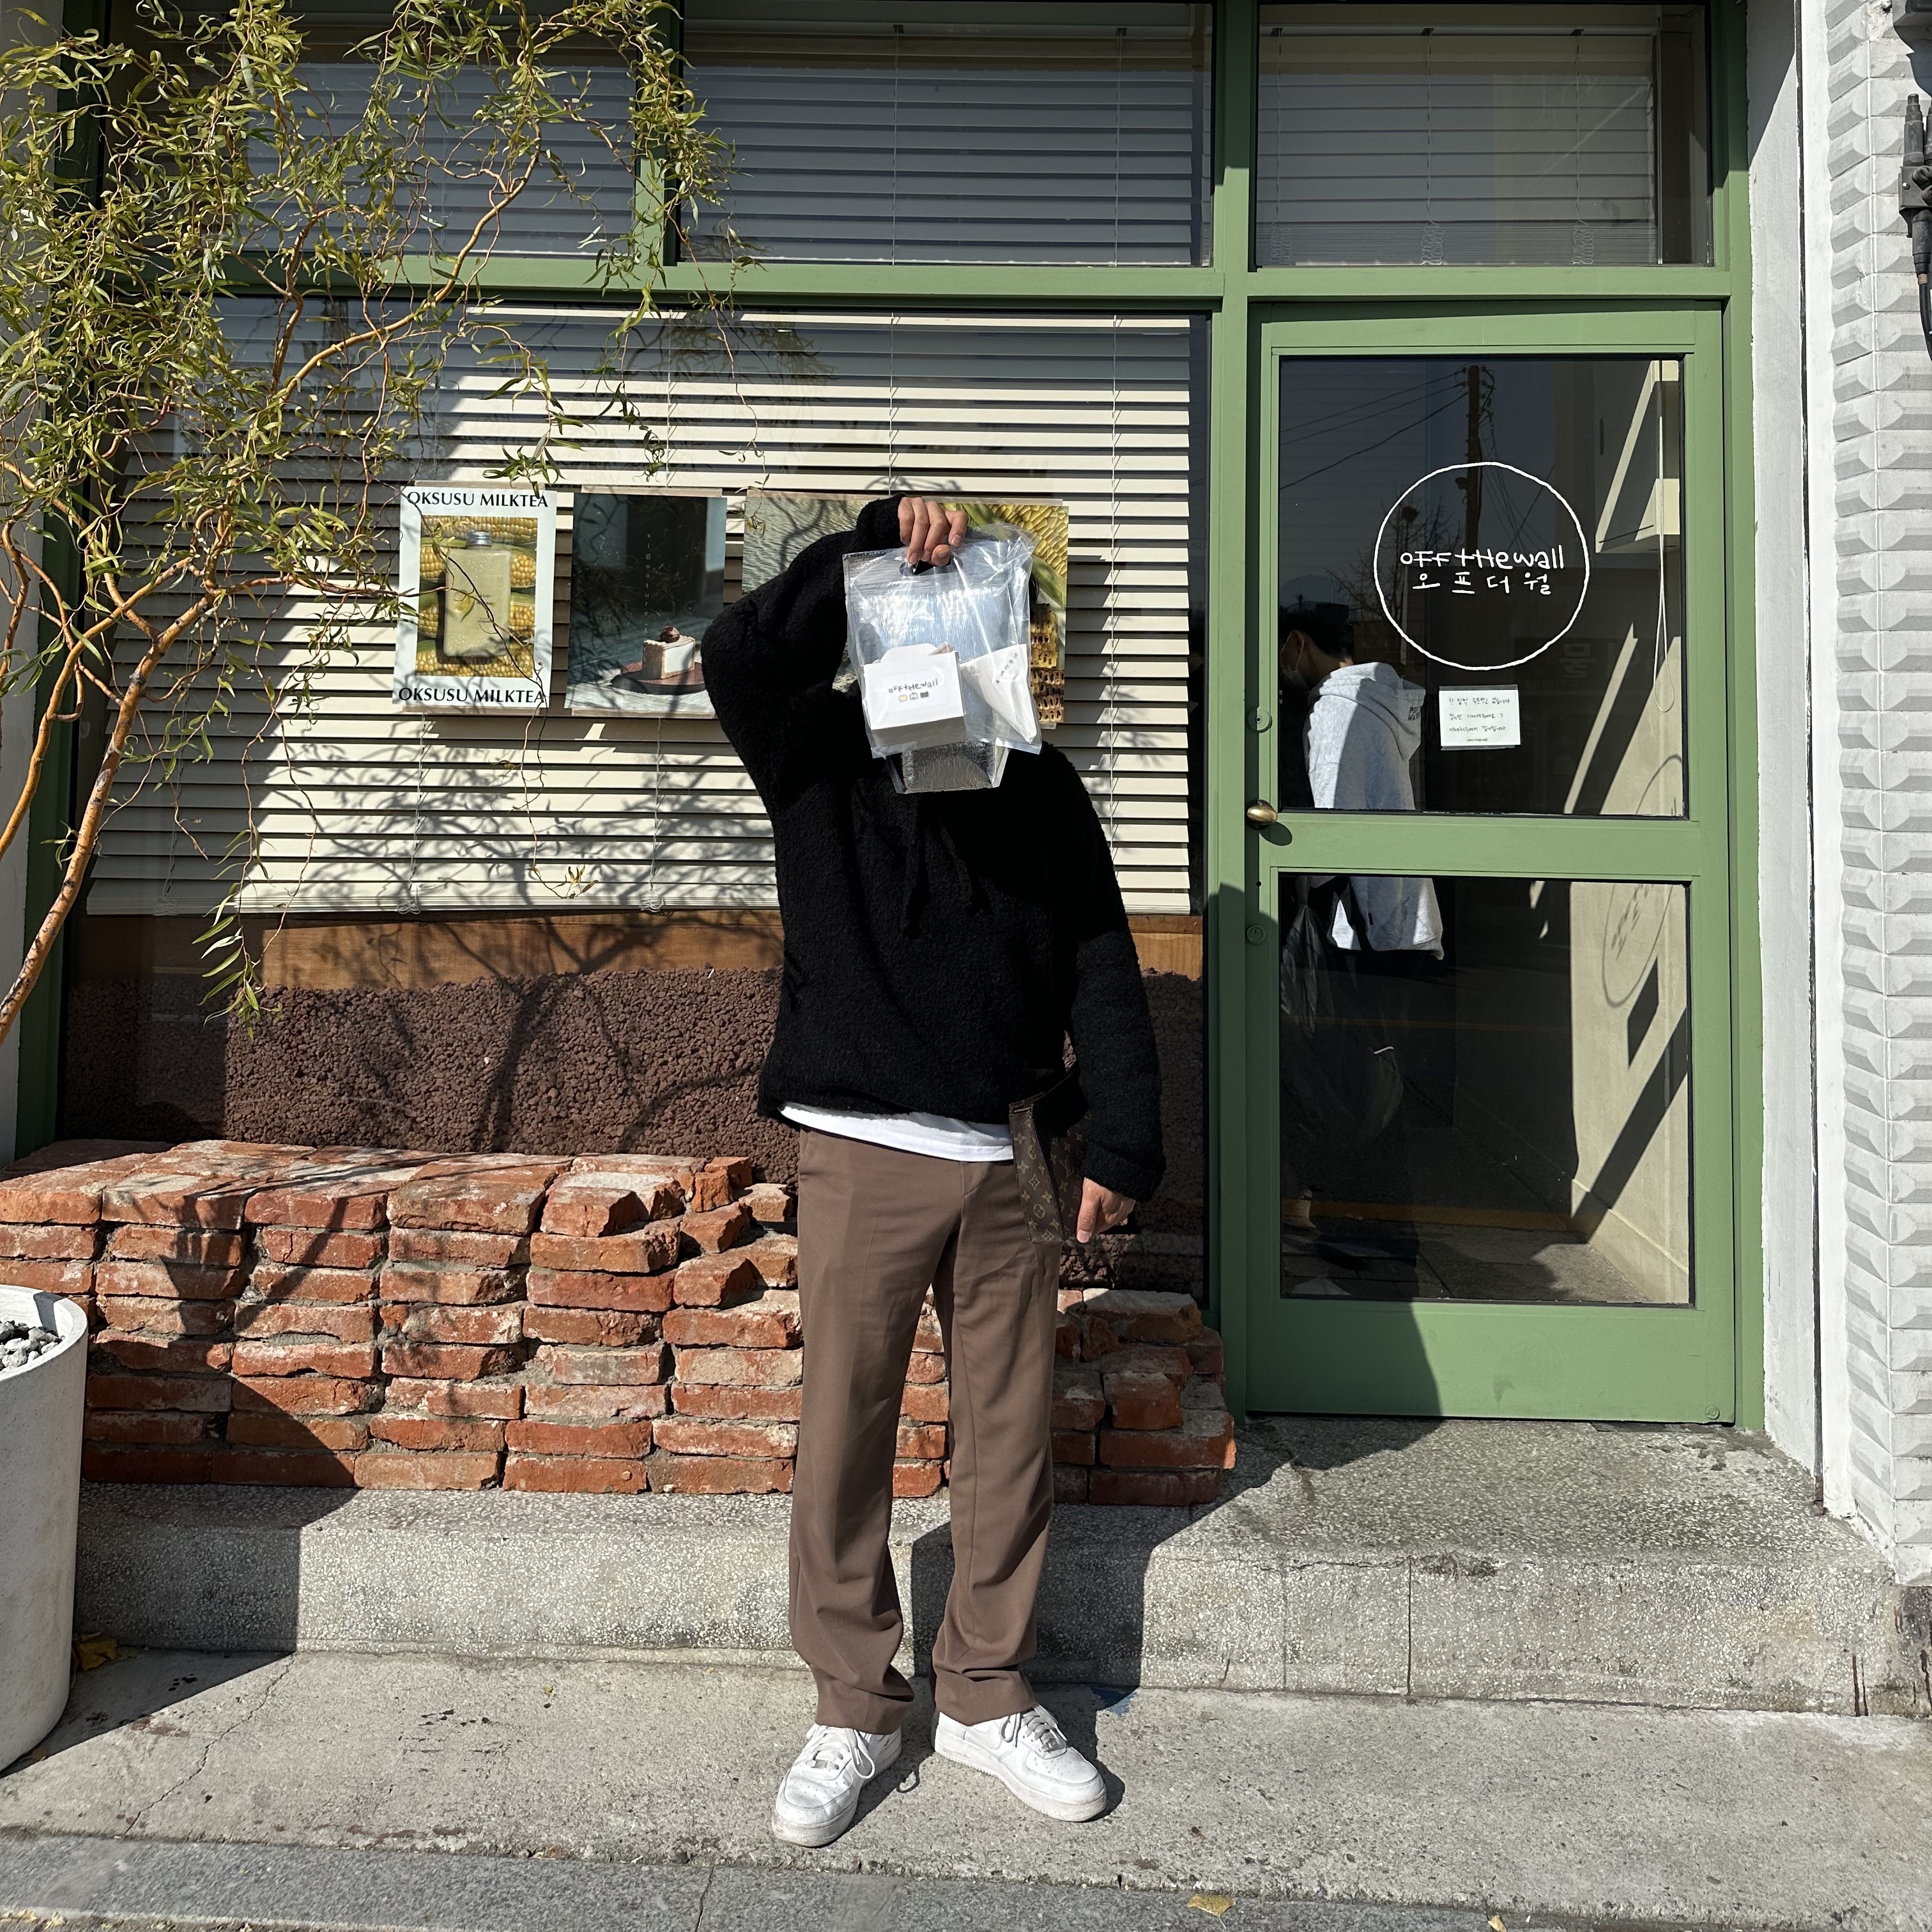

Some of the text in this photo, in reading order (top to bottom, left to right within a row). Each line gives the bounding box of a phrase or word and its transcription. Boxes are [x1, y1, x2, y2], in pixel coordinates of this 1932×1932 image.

[407, 491, 548, 508] OKSUSU MILKTEA
[399, 687, 545, 703] OKSUSU MILKTEA
